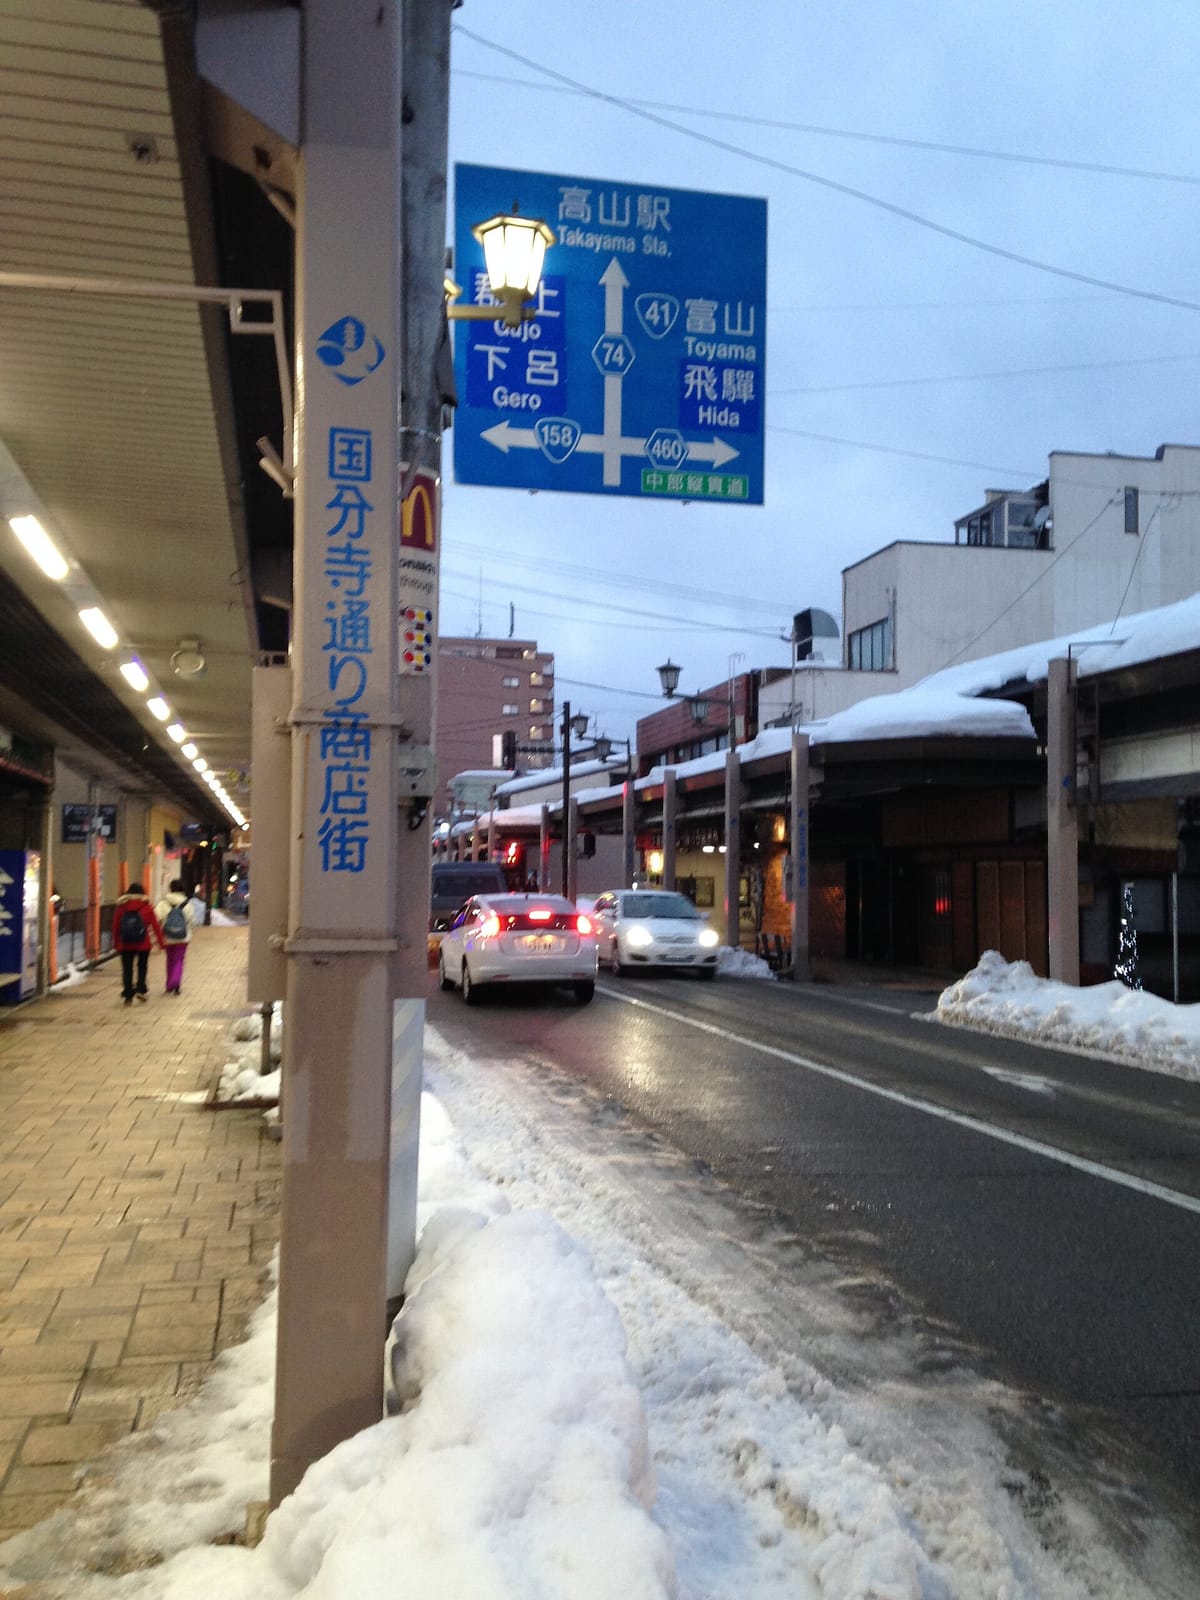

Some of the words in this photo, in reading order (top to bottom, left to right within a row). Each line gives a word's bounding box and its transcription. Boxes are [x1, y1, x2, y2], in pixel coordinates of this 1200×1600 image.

[558, 186, 672, 232] 高山駅
[557, 225, 636, 254] Takayama
[642, 234, 673, 258] Sta.
[645, 302, 671, 327] 41
[684, 298, 755, 336] 富山
[602, 343, 625, 367] 74
[684, 336, 756, 363] Toyama
[474, 344, 559, 387] 下呂
[492, 385, 542, 411] Gero
[698, 406, 740, 427] Hida
[540, 425, 573, 444] 158
[652, 439, 682, 461] 460
[319, 427, 374, 872] 国分寺通り商店街
